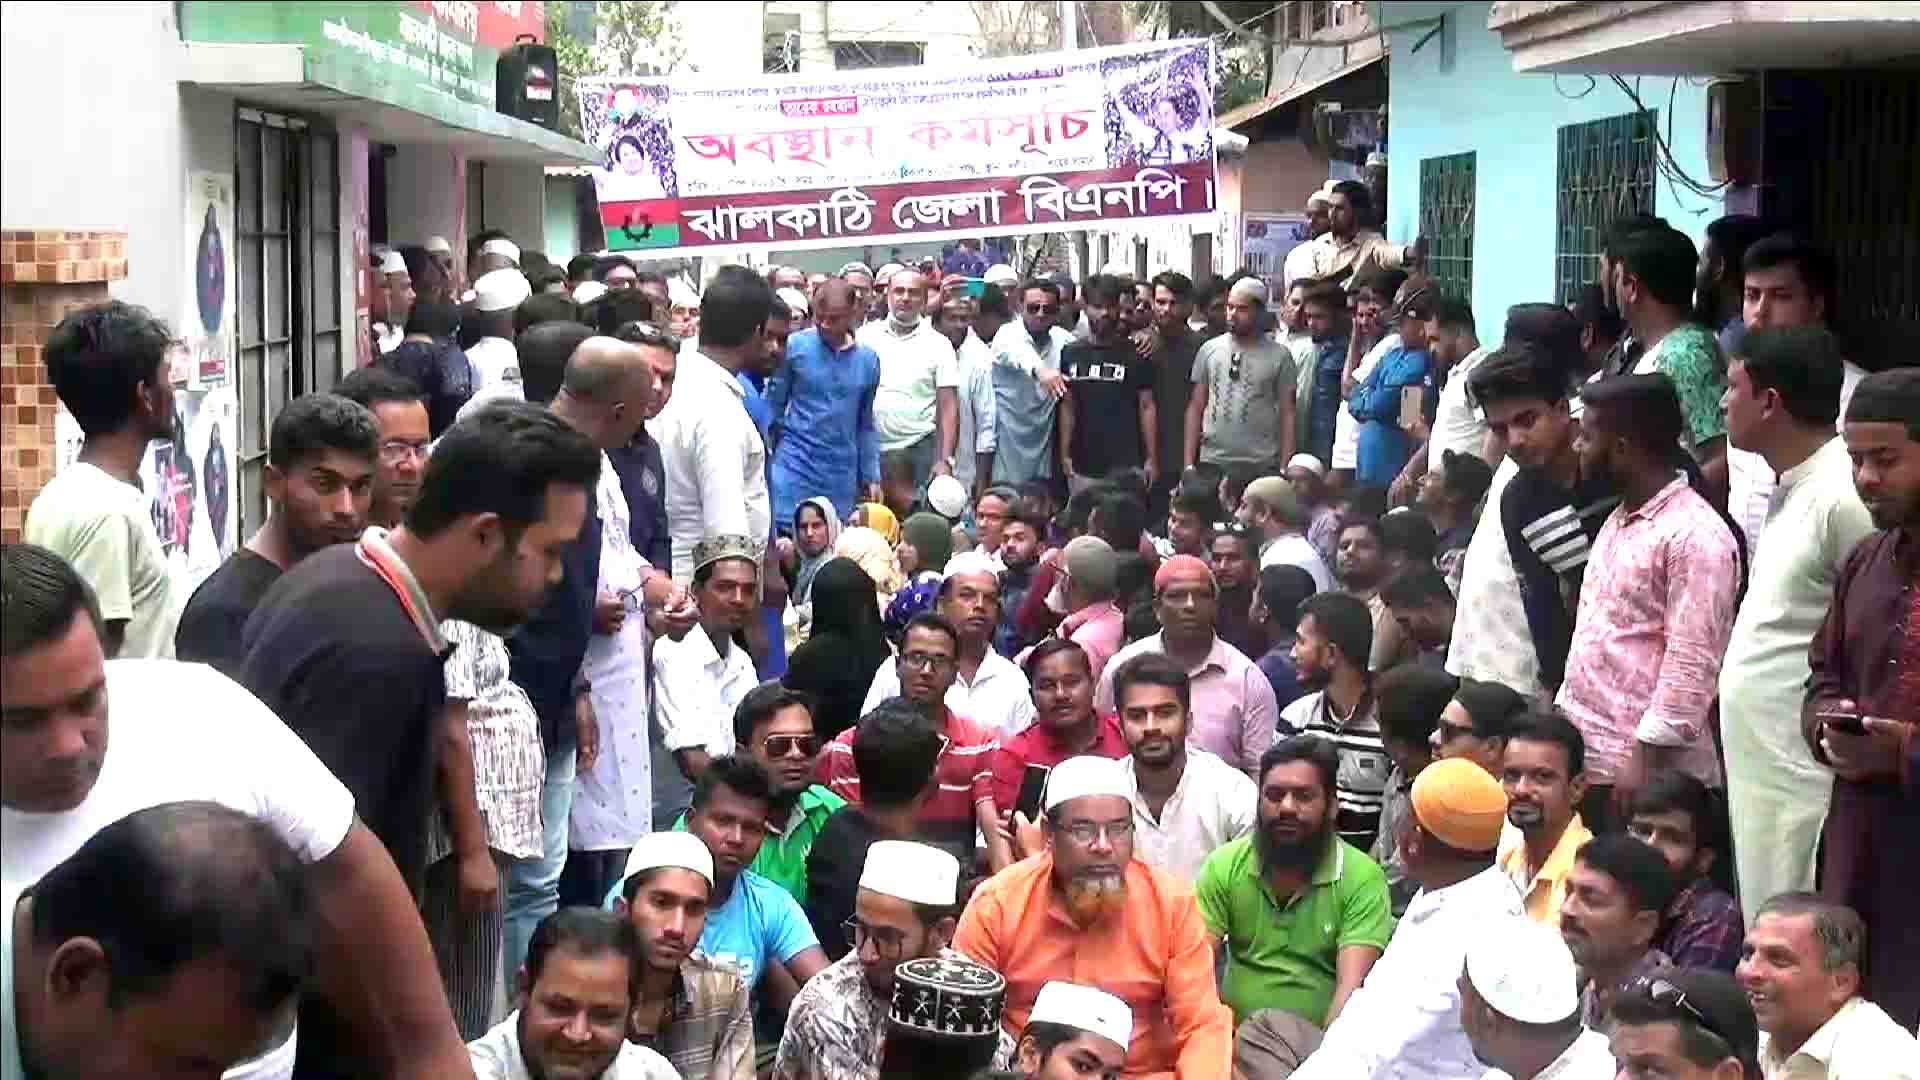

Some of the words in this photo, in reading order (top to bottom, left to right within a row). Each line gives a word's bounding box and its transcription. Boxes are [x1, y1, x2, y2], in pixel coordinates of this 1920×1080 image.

[682, 127, 876, 169] অবস্থান
[680, 187, 877, 241] ঝালকাঠি
[891, 187, 1009, 229] জেলা
[1016, 175, 1187, 222] বিএনপি
